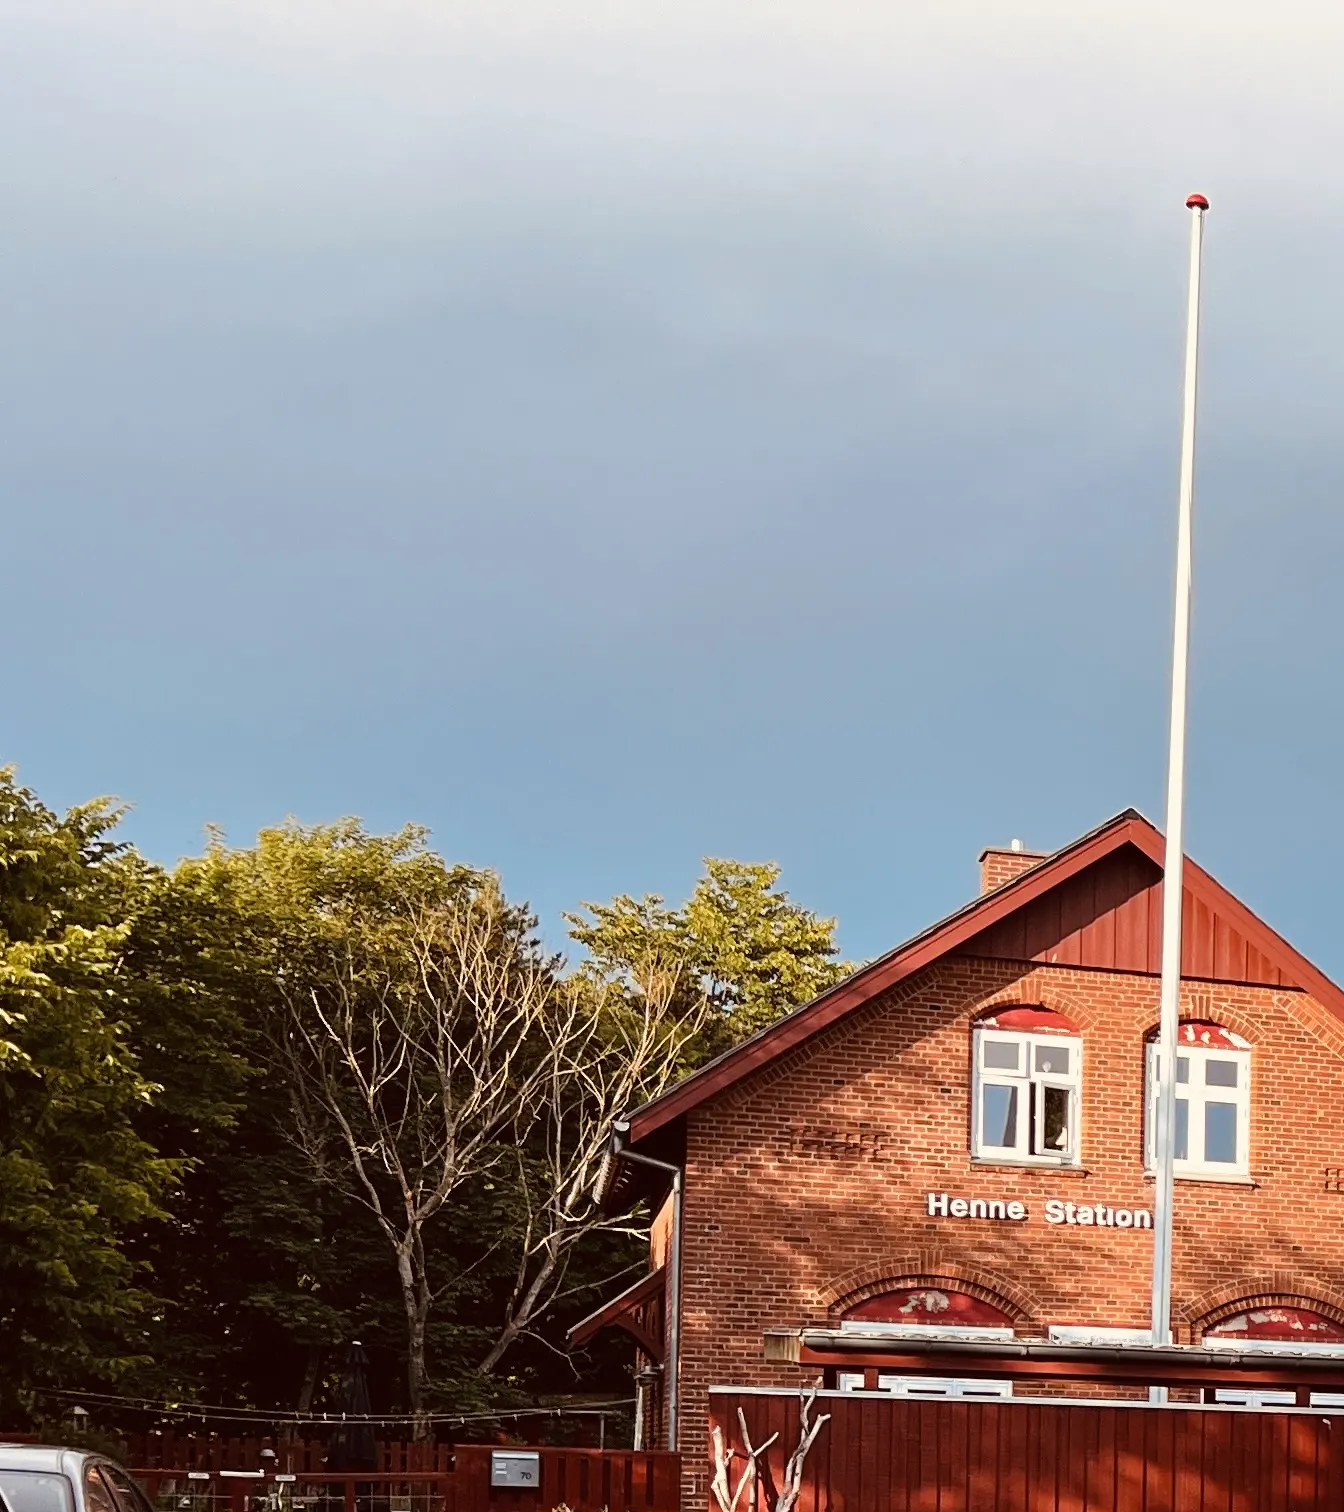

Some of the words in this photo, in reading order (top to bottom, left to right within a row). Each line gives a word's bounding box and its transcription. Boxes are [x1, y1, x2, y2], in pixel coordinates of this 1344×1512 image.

[928, 1193, 1026, 1219] Henne
[1044, 1199, 1152, 1228] Station
[521, 1471, 532, 1480] 70
